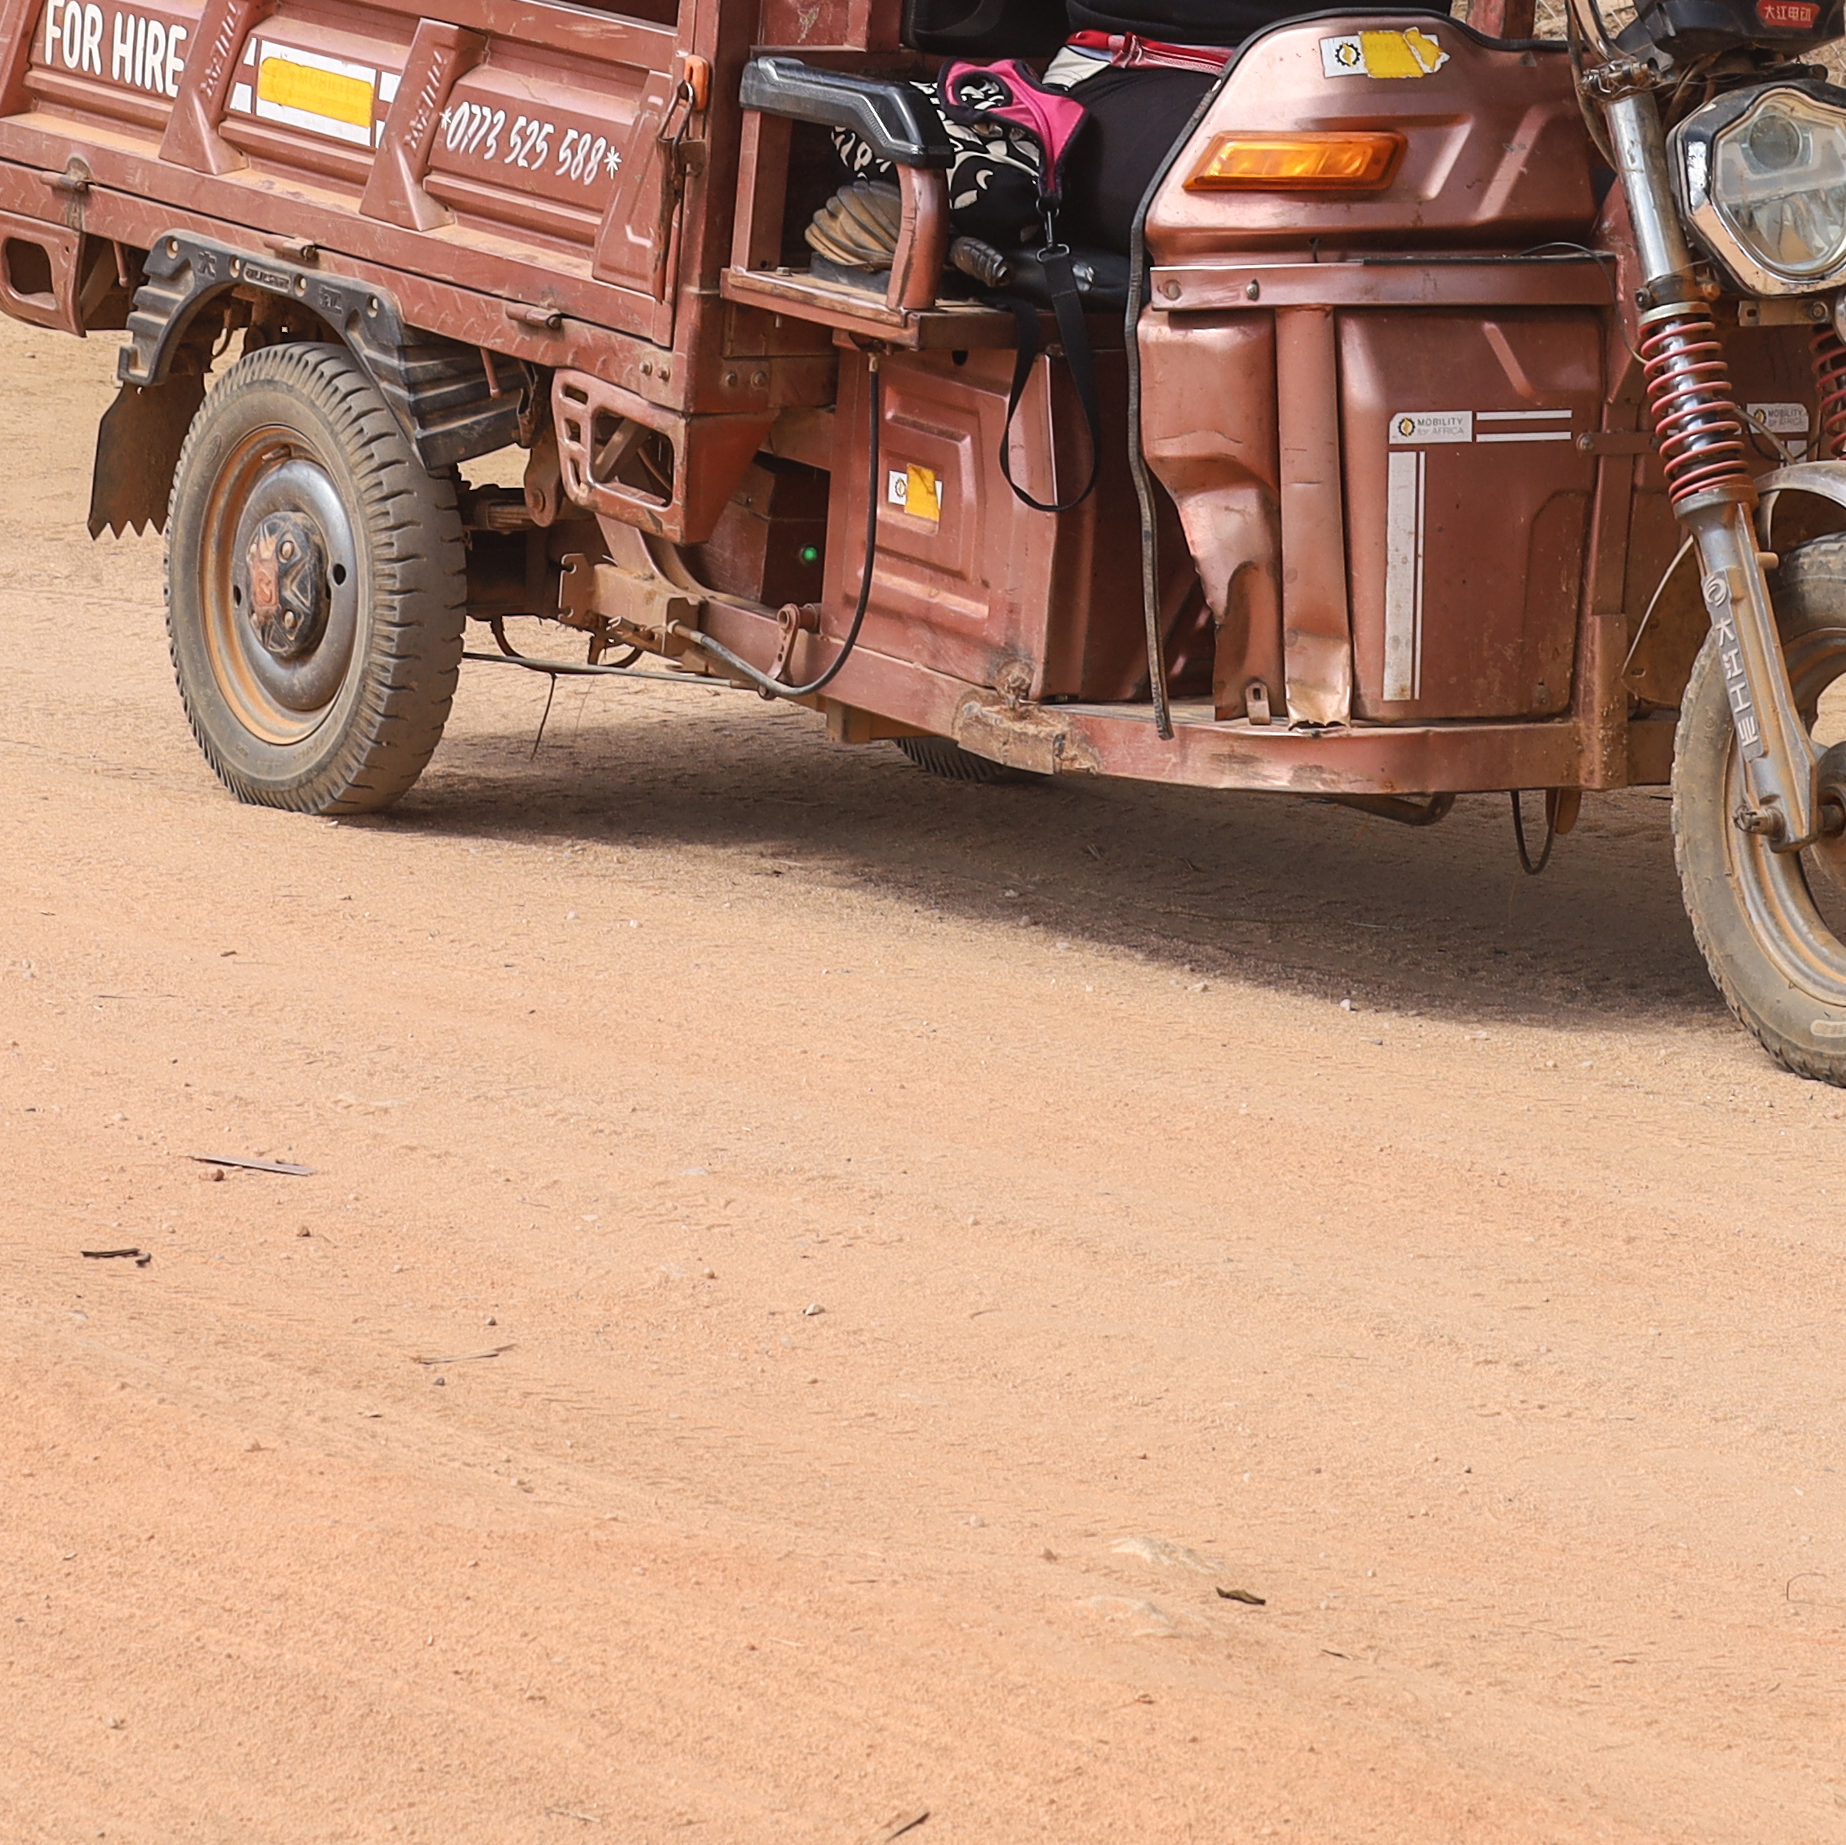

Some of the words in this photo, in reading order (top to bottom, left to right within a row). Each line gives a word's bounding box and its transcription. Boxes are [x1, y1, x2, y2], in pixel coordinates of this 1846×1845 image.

[1763, 5, 1812, 22] 大江电动
[111, 11, 188, 98] HIRE
[504, 115, 554, 171] 525
[1767, 409, 1804, 417] MOBILITY
[1417, 417, 1464, 427] MOBILITY
[1417, 428, 1431, 436] for
[1432, 427, 1464, 436] AFRICA
